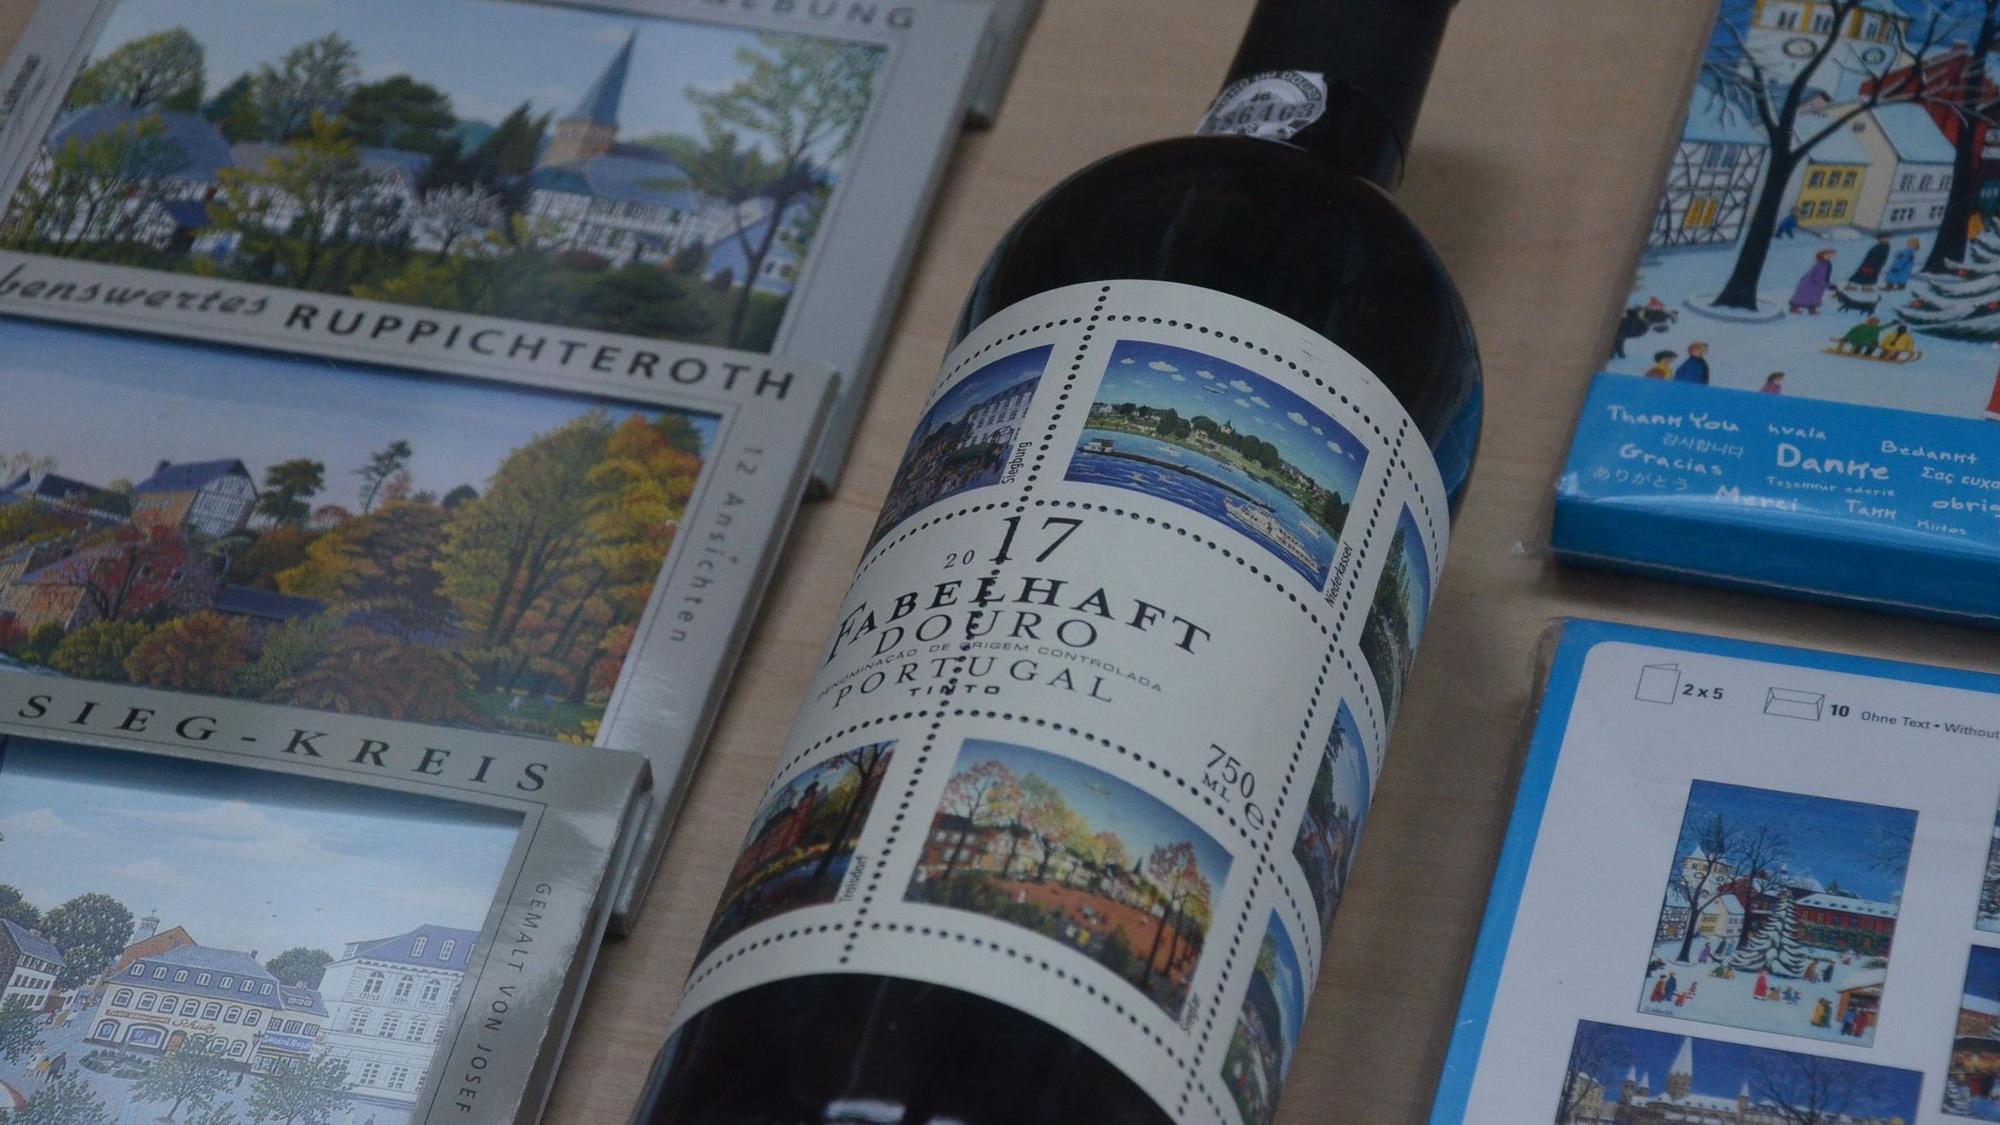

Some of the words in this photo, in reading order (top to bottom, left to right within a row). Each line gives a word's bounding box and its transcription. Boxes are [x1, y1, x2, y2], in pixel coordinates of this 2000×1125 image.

[284, 303, 796, 400] RUPPICHTEROTH
[1607, 405, 1683, 428] Thank
[1689, 412, 1740, 432] You
[1768, 423, 1827, 441] hvala
[736, 447, 764, 475] 12
[1001, 441, 1033, 485] Siegburg
[1620, 443, 1723, 476] Gracias
[1777, 443, 1890, 480] Danke
[1881, 440, 1978, 465] Bedankt
[1715, 484, 1799, 512] Merci
[670, 491, 744, 643] Ansichten
[1324, 541, 1353, 608] Niederkassel
[822, 576, 1211, 670] FABELHAFT
[871, 610, 1098, 658] DOURO
[832, 656, 1113, 710] PORTUGAL
[909, 684, 1001, 697] TINTO
[929, 643, 951, 654] DE
[958, 641, 1029, 653] ORIGEM
[1038, 646, 1162, 693] CONTROLADA
[18, 694, 549, 793] SIEG-KREIS
[1829, 703, 1851, 719] 10
[1861, 710, 1897, 726] Ohne
[1902, 716, 1931, 731] Text
[1944, 722, 2000, 741] Without
[1202, 772, 1231, 804] ML
[1207, 743, 1256, 799] 750
[507, 882, 552, 973] GEMALT
[484, 984, 516, 1032] VON
[455, 1043, 493, 1115] JOSEF
